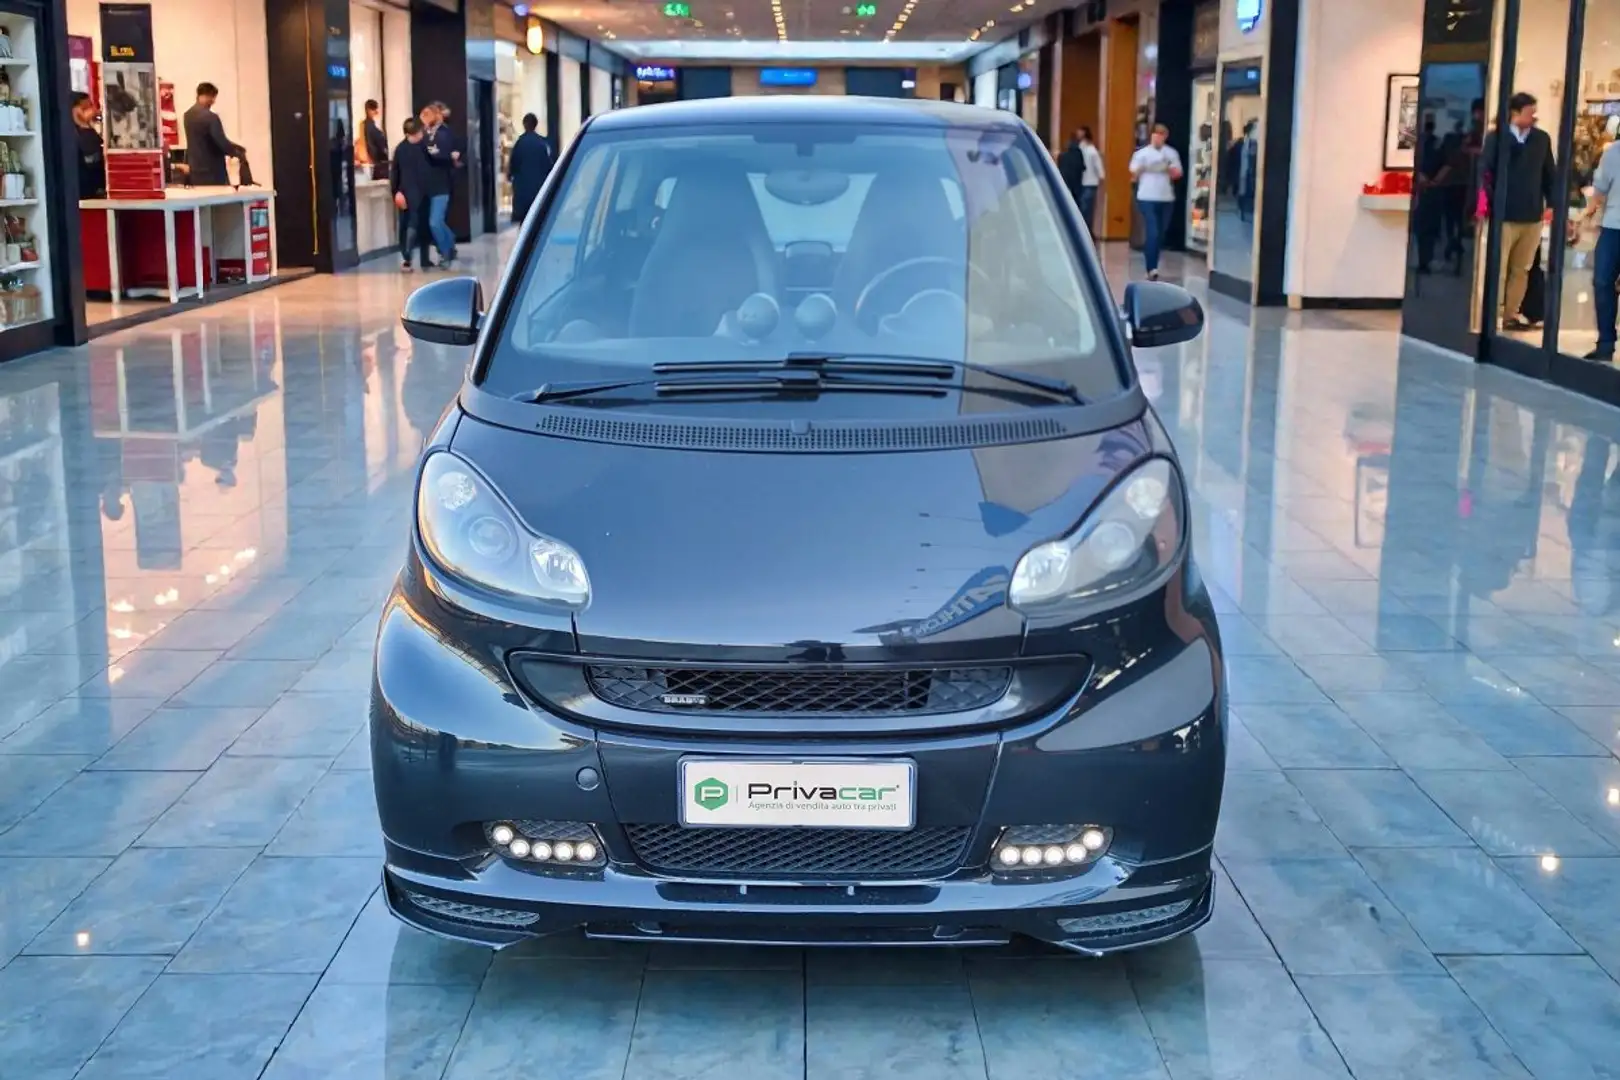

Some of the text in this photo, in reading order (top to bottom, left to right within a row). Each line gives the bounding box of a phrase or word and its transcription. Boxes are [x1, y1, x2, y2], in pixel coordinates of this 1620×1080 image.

[748, 781, 896, 801] Privacar
[748, 801, 783, 811] Agenzia
[785, 801, 794, 810] di
[795, 802, 829, 810] vendita
